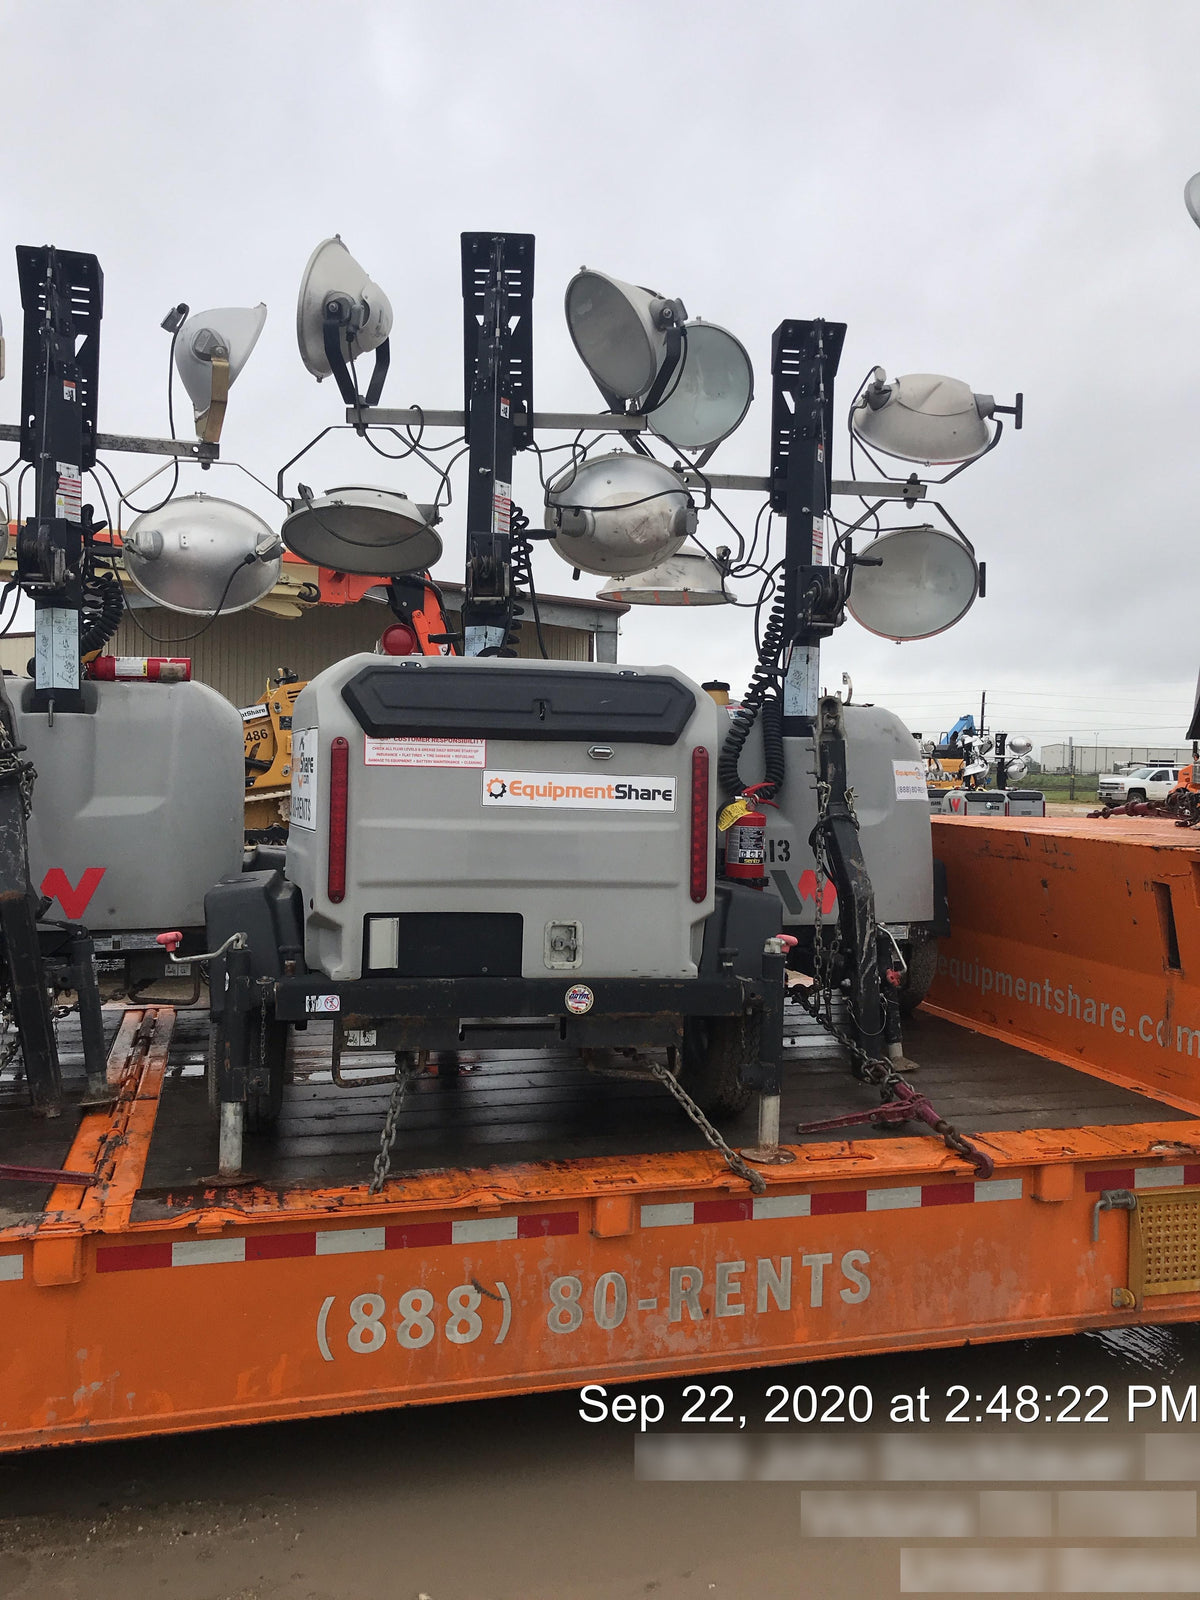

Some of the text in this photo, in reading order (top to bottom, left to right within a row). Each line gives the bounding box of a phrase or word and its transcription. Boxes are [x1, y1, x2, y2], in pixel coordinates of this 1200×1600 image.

[244, 729, 268, 743] 486
[509, 780, 673, 802] EquipmentShare
[763, 839, 791, 863] 13
[316, 1249, 872, 1361] (888) 80-RENTS
